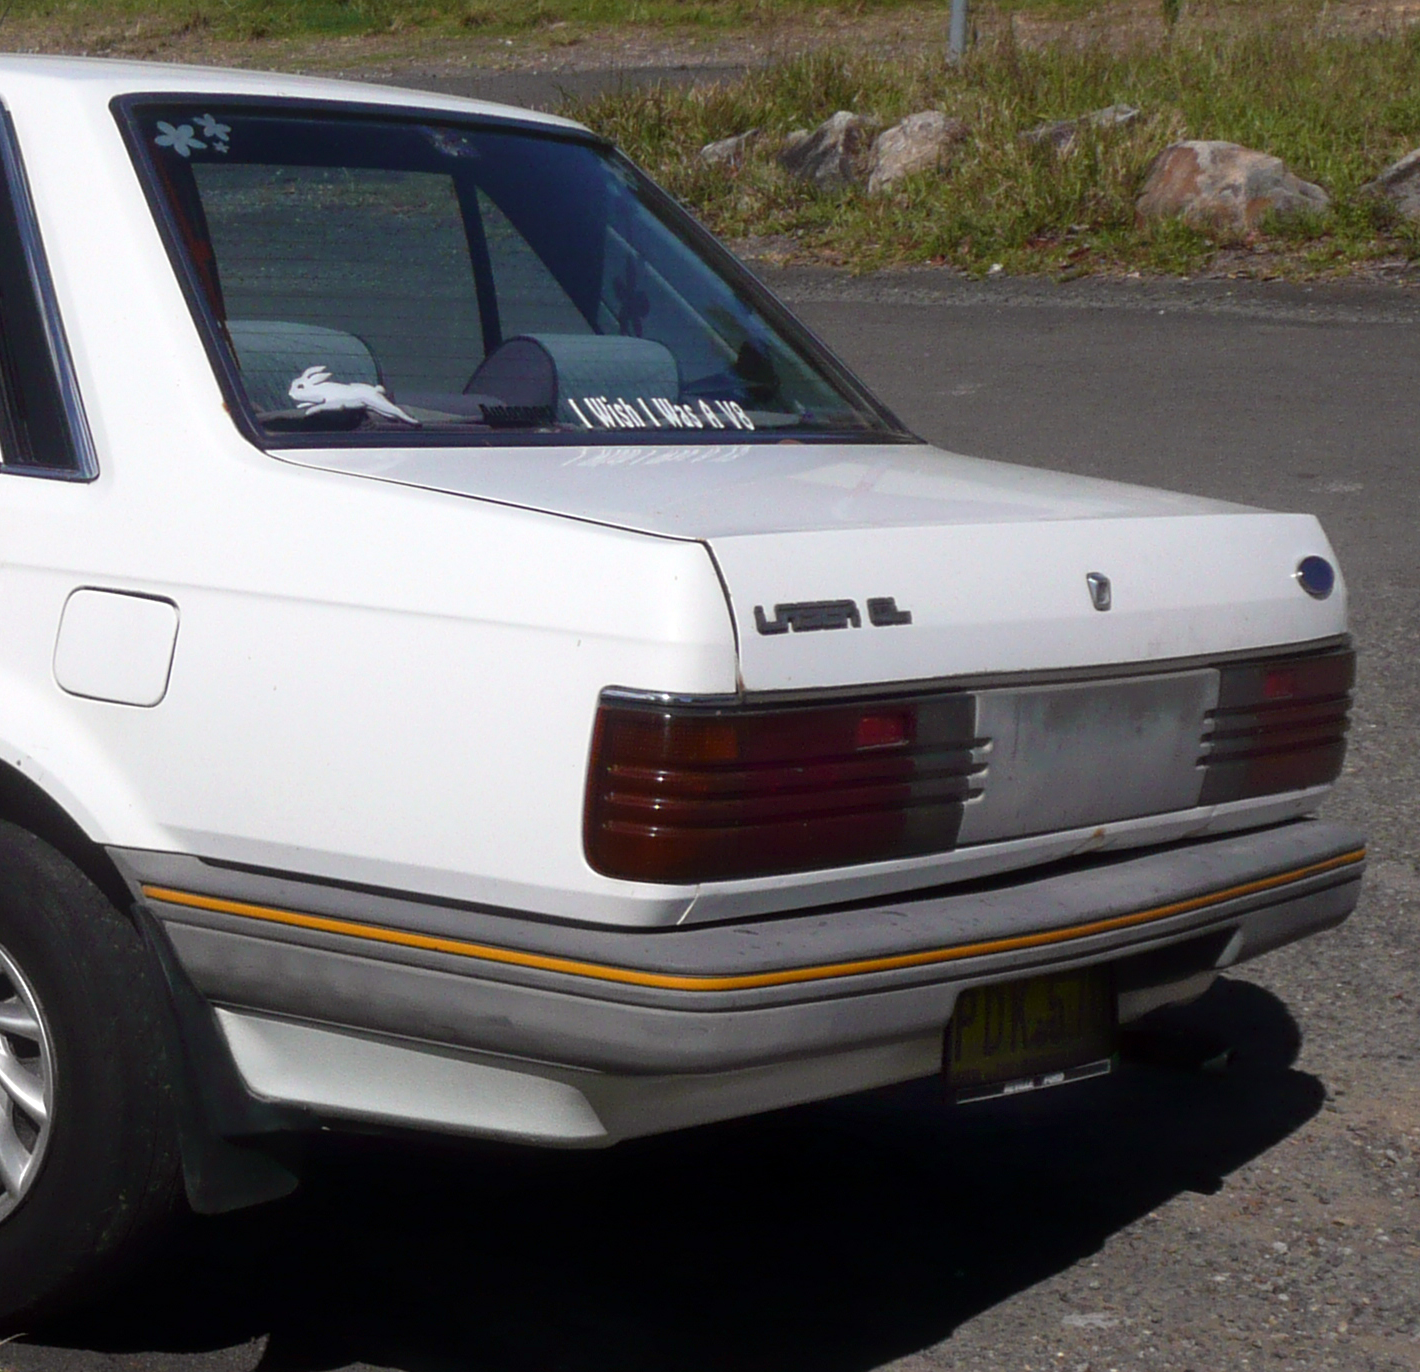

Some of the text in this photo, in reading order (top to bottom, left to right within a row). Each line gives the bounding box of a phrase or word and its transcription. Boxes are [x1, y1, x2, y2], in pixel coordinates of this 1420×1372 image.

[568, 396, 756, 431] I Wish I Was A V8
